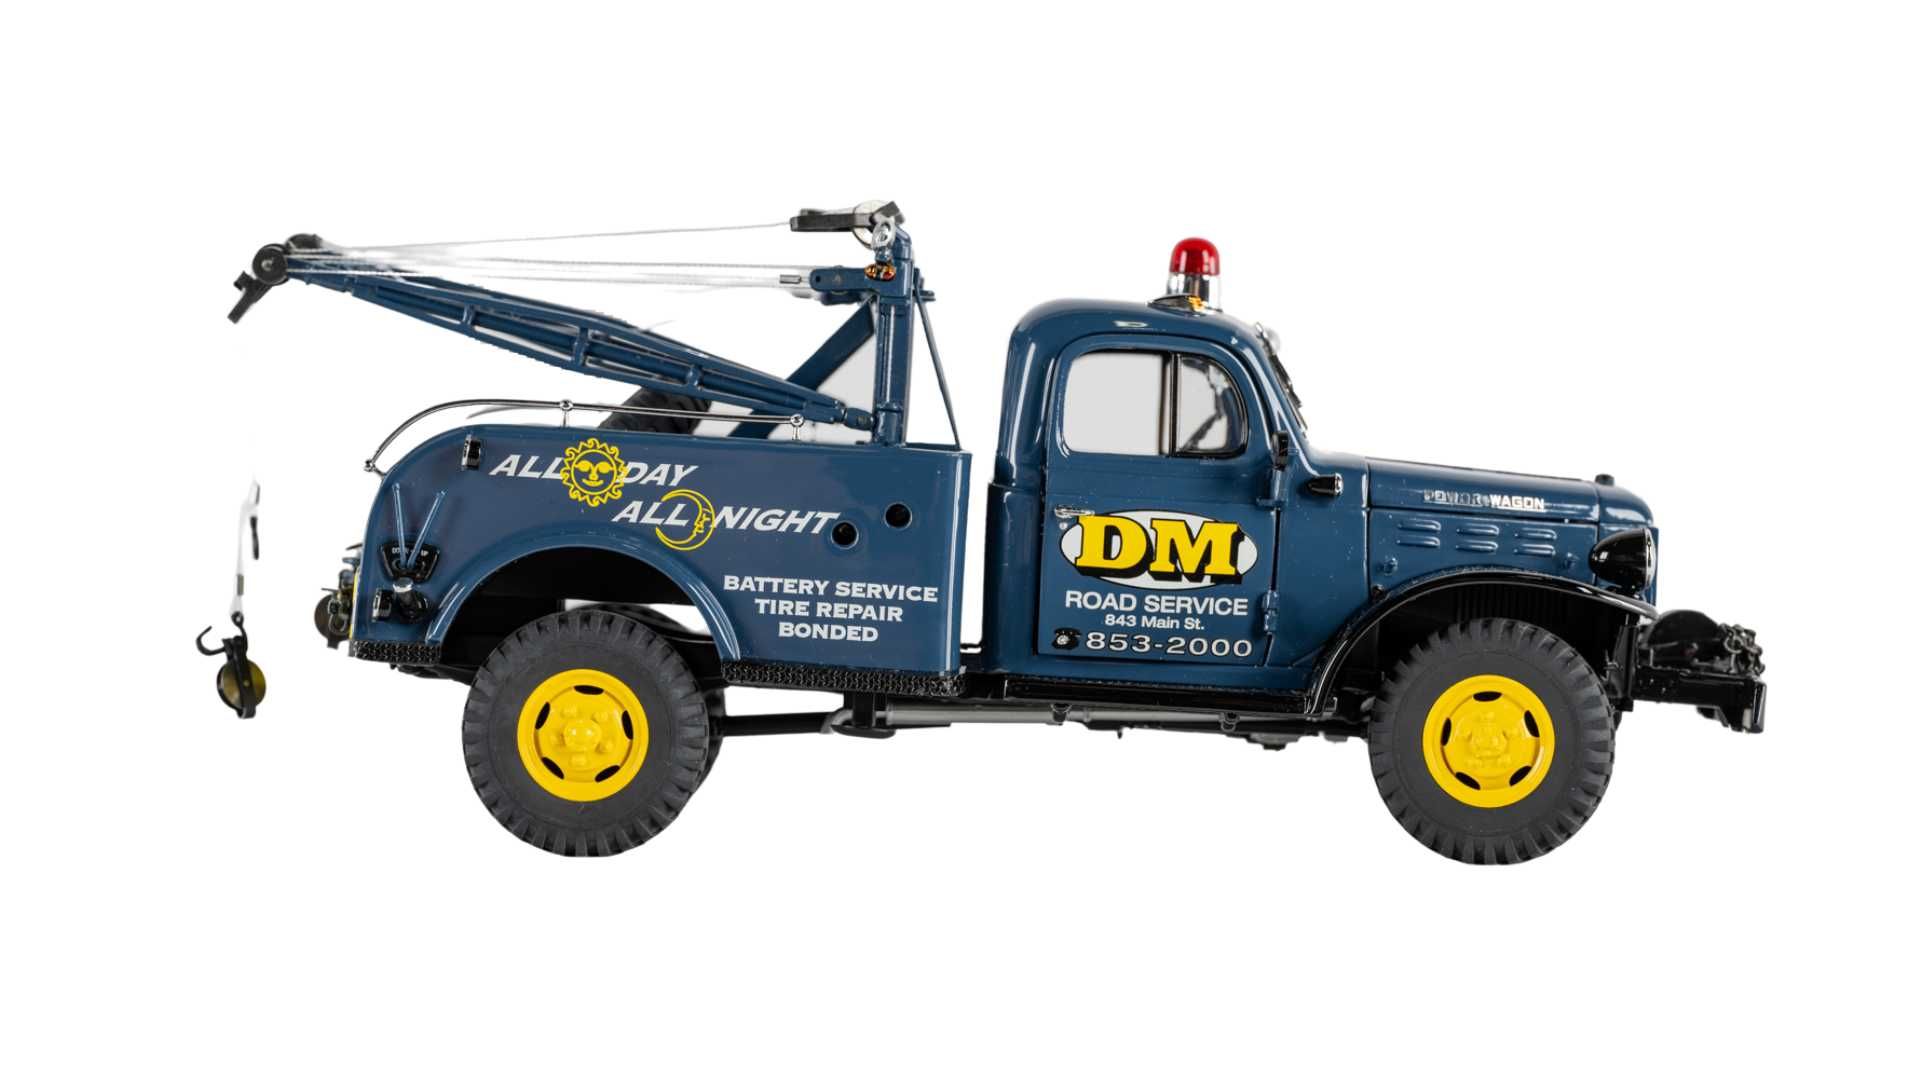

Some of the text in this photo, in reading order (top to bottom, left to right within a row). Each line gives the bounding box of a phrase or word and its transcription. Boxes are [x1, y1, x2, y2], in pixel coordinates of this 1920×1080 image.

[488, 454, 699, 487] ALL DAY
[1488, 493, 1546, 512] WAGON
[611, 500, 841, 534] ALL NIGHT
[1074, 514, 1246, 584] DM
[723, 574, 939, 602] BATTERY SERVICE
[754, 598, 904, 622] TIRE REPAIR
[1065, 590, 1249, 616] ROAD SERVICE
[778, 621, 879, 642] BONDED
[1104, 614, 1205, 631] 843 Main St.
[1085, 631, 1253, 657] 853-2000
